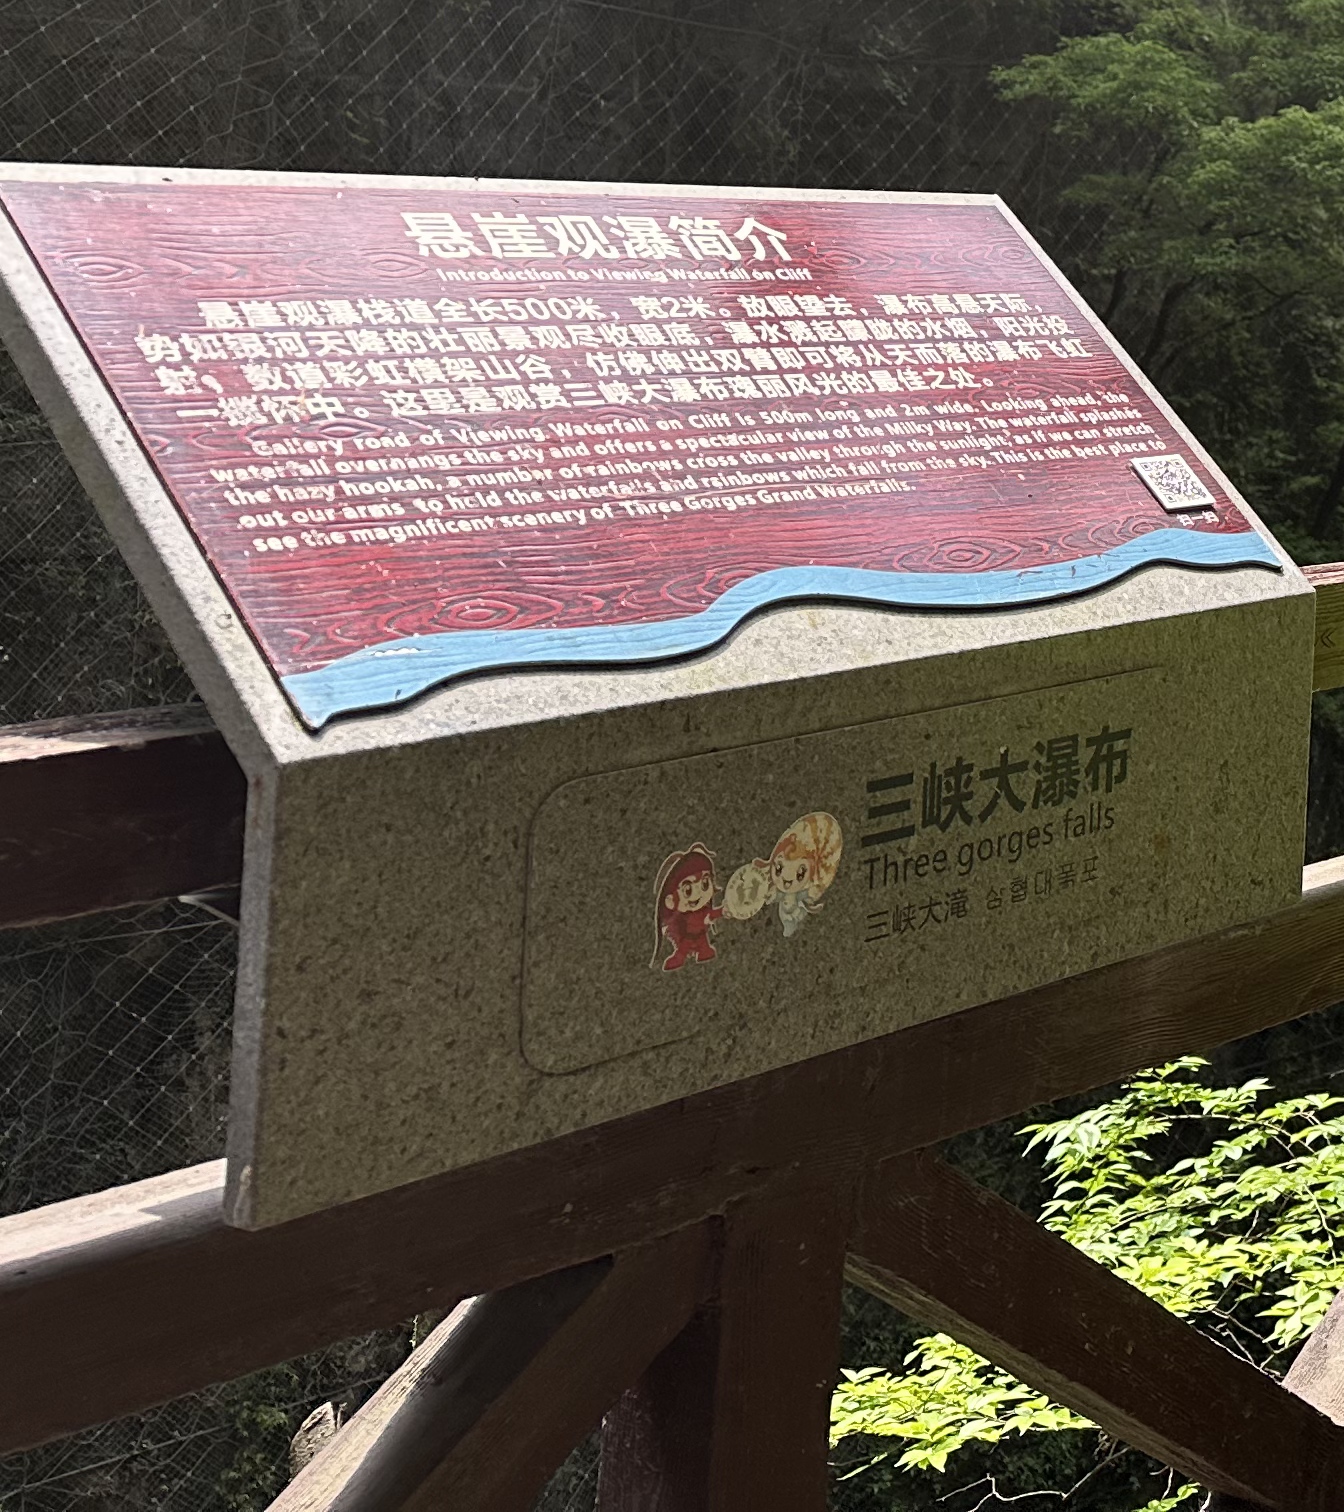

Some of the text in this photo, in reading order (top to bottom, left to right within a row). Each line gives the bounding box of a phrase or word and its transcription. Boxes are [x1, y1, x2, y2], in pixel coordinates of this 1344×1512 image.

[400, 211, 793, 262] 悬崖观瀑简介
[437, 268, 813, 284] Introduction to Viewing Waterfall on Cliff
[210, 407, 1142, 482] waterfall overhangs the sky and offers a spectacular view of the Milky Way. The waterfall splashes
[250, 437, 344, 456] Gallery
[353, 432, 412, 451] road
[419, 430, 444, 446] of
[548, 418, 650, 438] Waterfall
[655, 419, 683, 431] on
[688, 413, 731, 429] Cliff
[735, 413, 756, 427] is
[758, 408, 813, 425] 500m
[815, 407, 860, 423] long
[863, 403, 898, 419] and
[901, 403, 930, 417] 2m
[933, 399, 979, 416] wide.
[980, 396, 1048, 413] Looking
[1102, 390, 1129, 404] the
[223, 488, 272, 506] the
[277, 485, 336, 502] hazy
[338, 475, 443, 497] hookah,
[445, 474, 463, 488] a
[558, 463, 583, 480] of
[586, 458, 683, 477] rainbows
[686, 454, 738, 469] cross
[740, 451, 775, 465] the
[775, 445, 831, 463] valley
[833, 440, 906, 459] through
[906, 438, 937, 452] the
[1014, 433, 1033, 445] as
[1031, 429, 1048, 443] if
[1048, 429, 1074, 441] we
[1074, 428, 1101, 440] can
[1102, 422, 1155, 438] stretch
[239, 509, 288, 528] out
[291, 507, 336, 523] our
[340, 500, 405, 520] arms
[412, 497, 444, 513] to
[445, 492, 503, 511] hold
[503, 489, 545, 505] the
[549, 479, 656, 501] waterfalls
[657, 475, 698, 491] and
[700, 469, 790, 489] rainbows
[791, 463, 850, 480] which
[848, 461, 881, 477] fall
[881, 458, 926, 474] from
[926, 456, 956, 470] the
[990, 451, 1028, 466] This
[1028, 449, 1045, 462] is
[1046, 447, 1075, 461] the
[1075, 444, 1107, 460] best
[1109, 441, 1148, 457] place
[1147, 438, 1167, 451] to
[252, 536, 299, 552] see
[301, 530, 346, 547] the
[349, 515, 494, 544] magnificent
[500, 506, 588, 528] scenery
[591, 503, 617, 520] of
[619, 498, 683, 517] Three
[683, 492, 757, 511] Gorges
[757, 484, 817, 504] Grand
[860, 724, 1133, 848] 三峡大瀑布
[862, 801, 1116, 889] Three gorges falls
